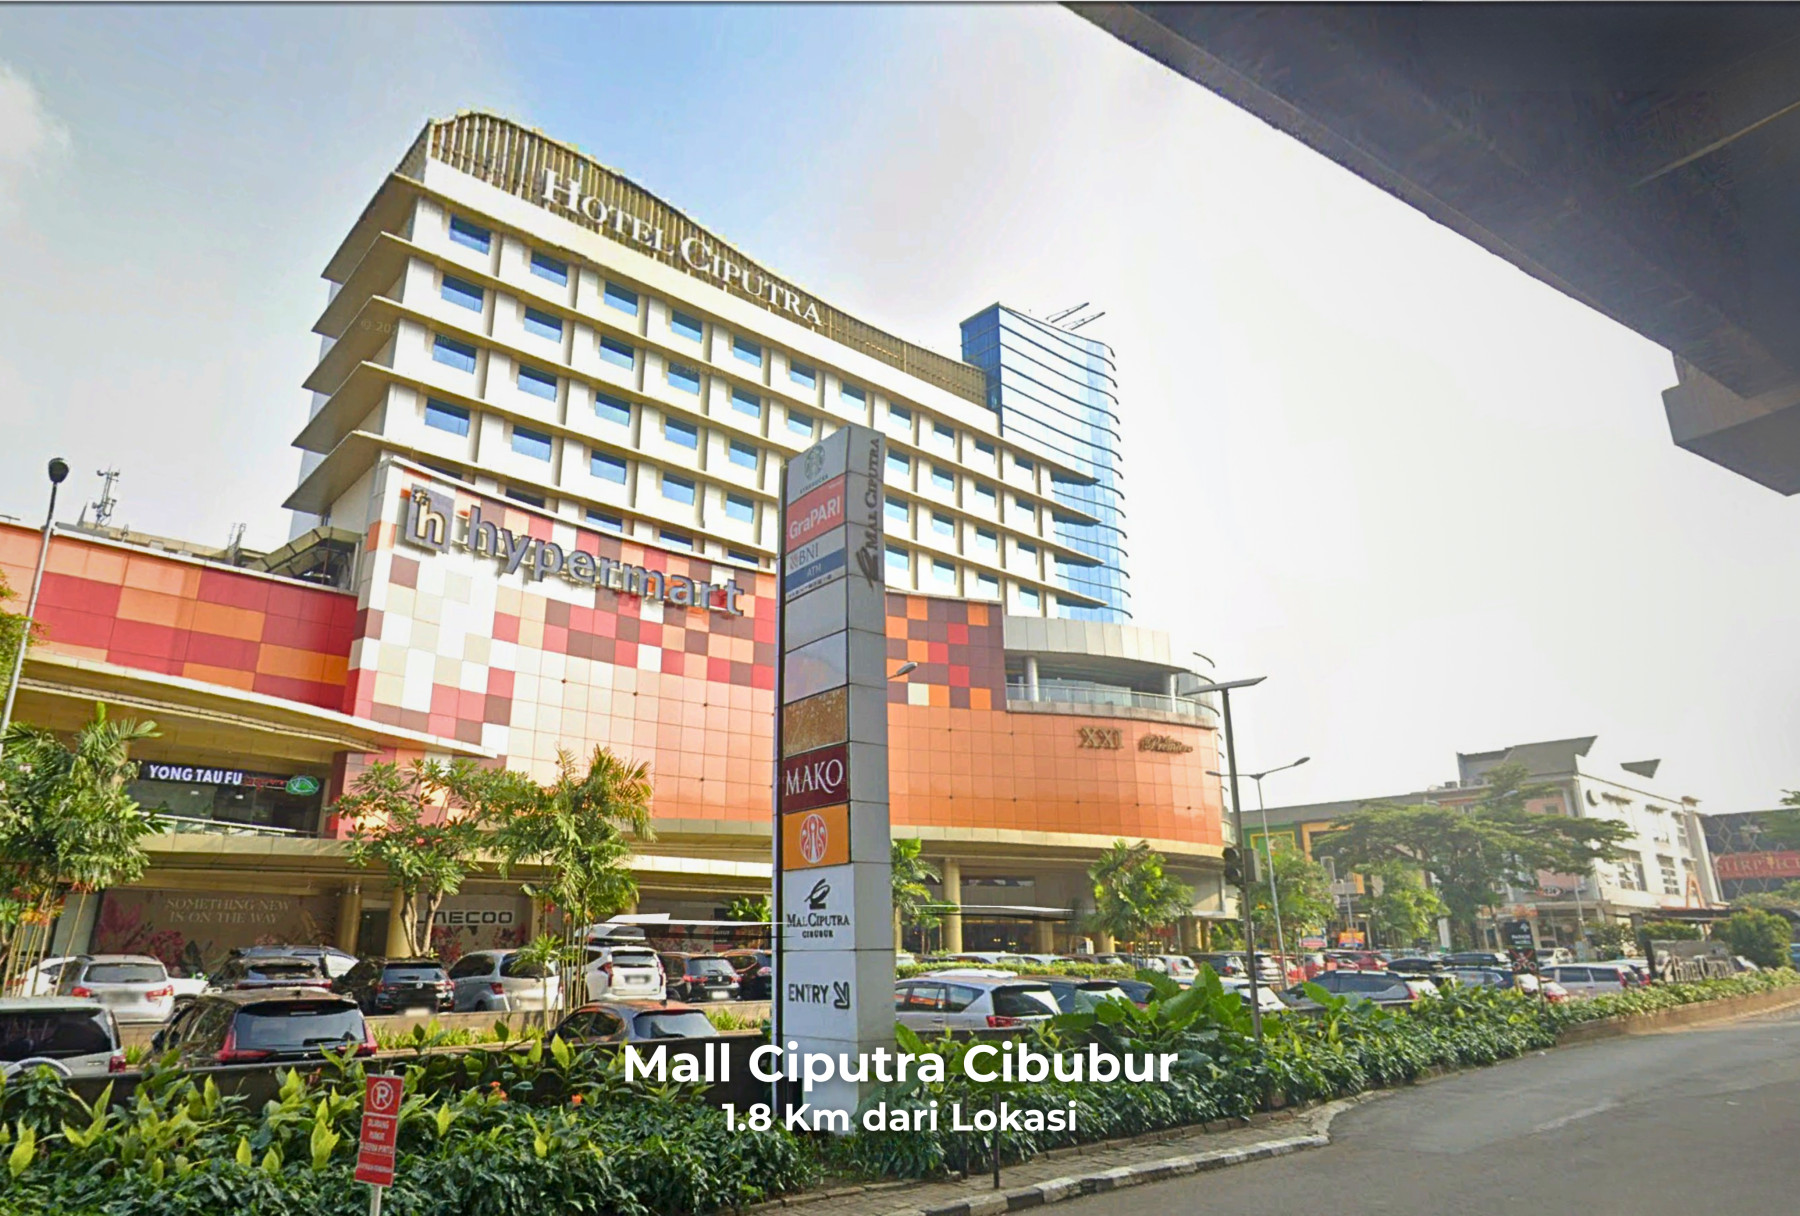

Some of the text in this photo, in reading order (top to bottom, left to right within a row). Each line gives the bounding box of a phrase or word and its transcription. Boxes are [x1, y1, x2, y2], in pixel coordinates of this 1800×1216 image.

[541, 165, 822, 327] HOTEL CIPUTRA
[865, 438, 880, 508] CIPUTRA
[789, 495, 842, 539] GraPARI
[467, 505, 745, 616] hypermart
[799, 543, 819, 566] BNI
[149, 765, 193, 781] YONG
[196, 769, 223, 783] TAU
[224, 772, 243, 785] FU
[785, 758, 844, 797] MAKO
[808, 912, 850, 927] CIPUTRA
[788, 983, 829, 1004] ENTRY
